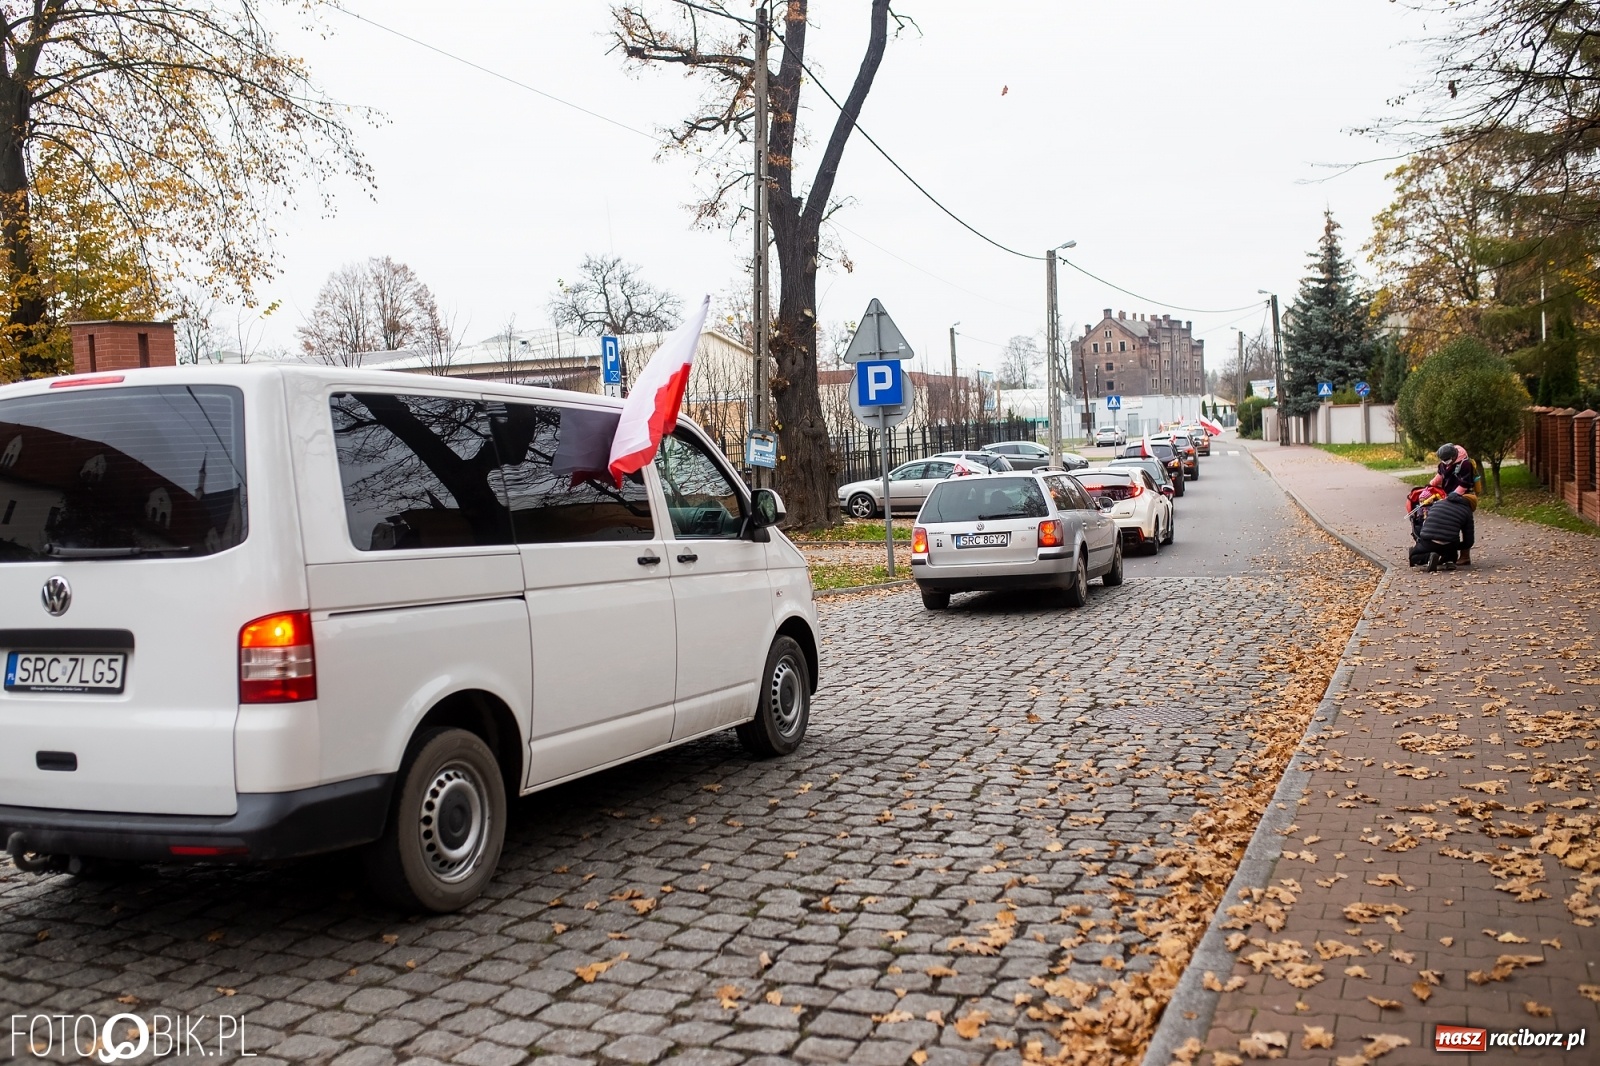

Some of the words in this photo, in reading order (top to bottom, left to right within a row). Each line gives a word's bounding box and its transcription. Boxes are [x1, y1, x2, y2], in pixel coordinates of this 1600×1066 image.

[605, 340, 616, 370] P
[867, 365, 893, 401] P
[749, 433, 774, 462] P
[961, 536, 981, 546] SRC
[983, 534, 1006, 544] 8GY2
[18, 657, 61, 683] SRC
[66, 657, 119, 684] 7LG5
